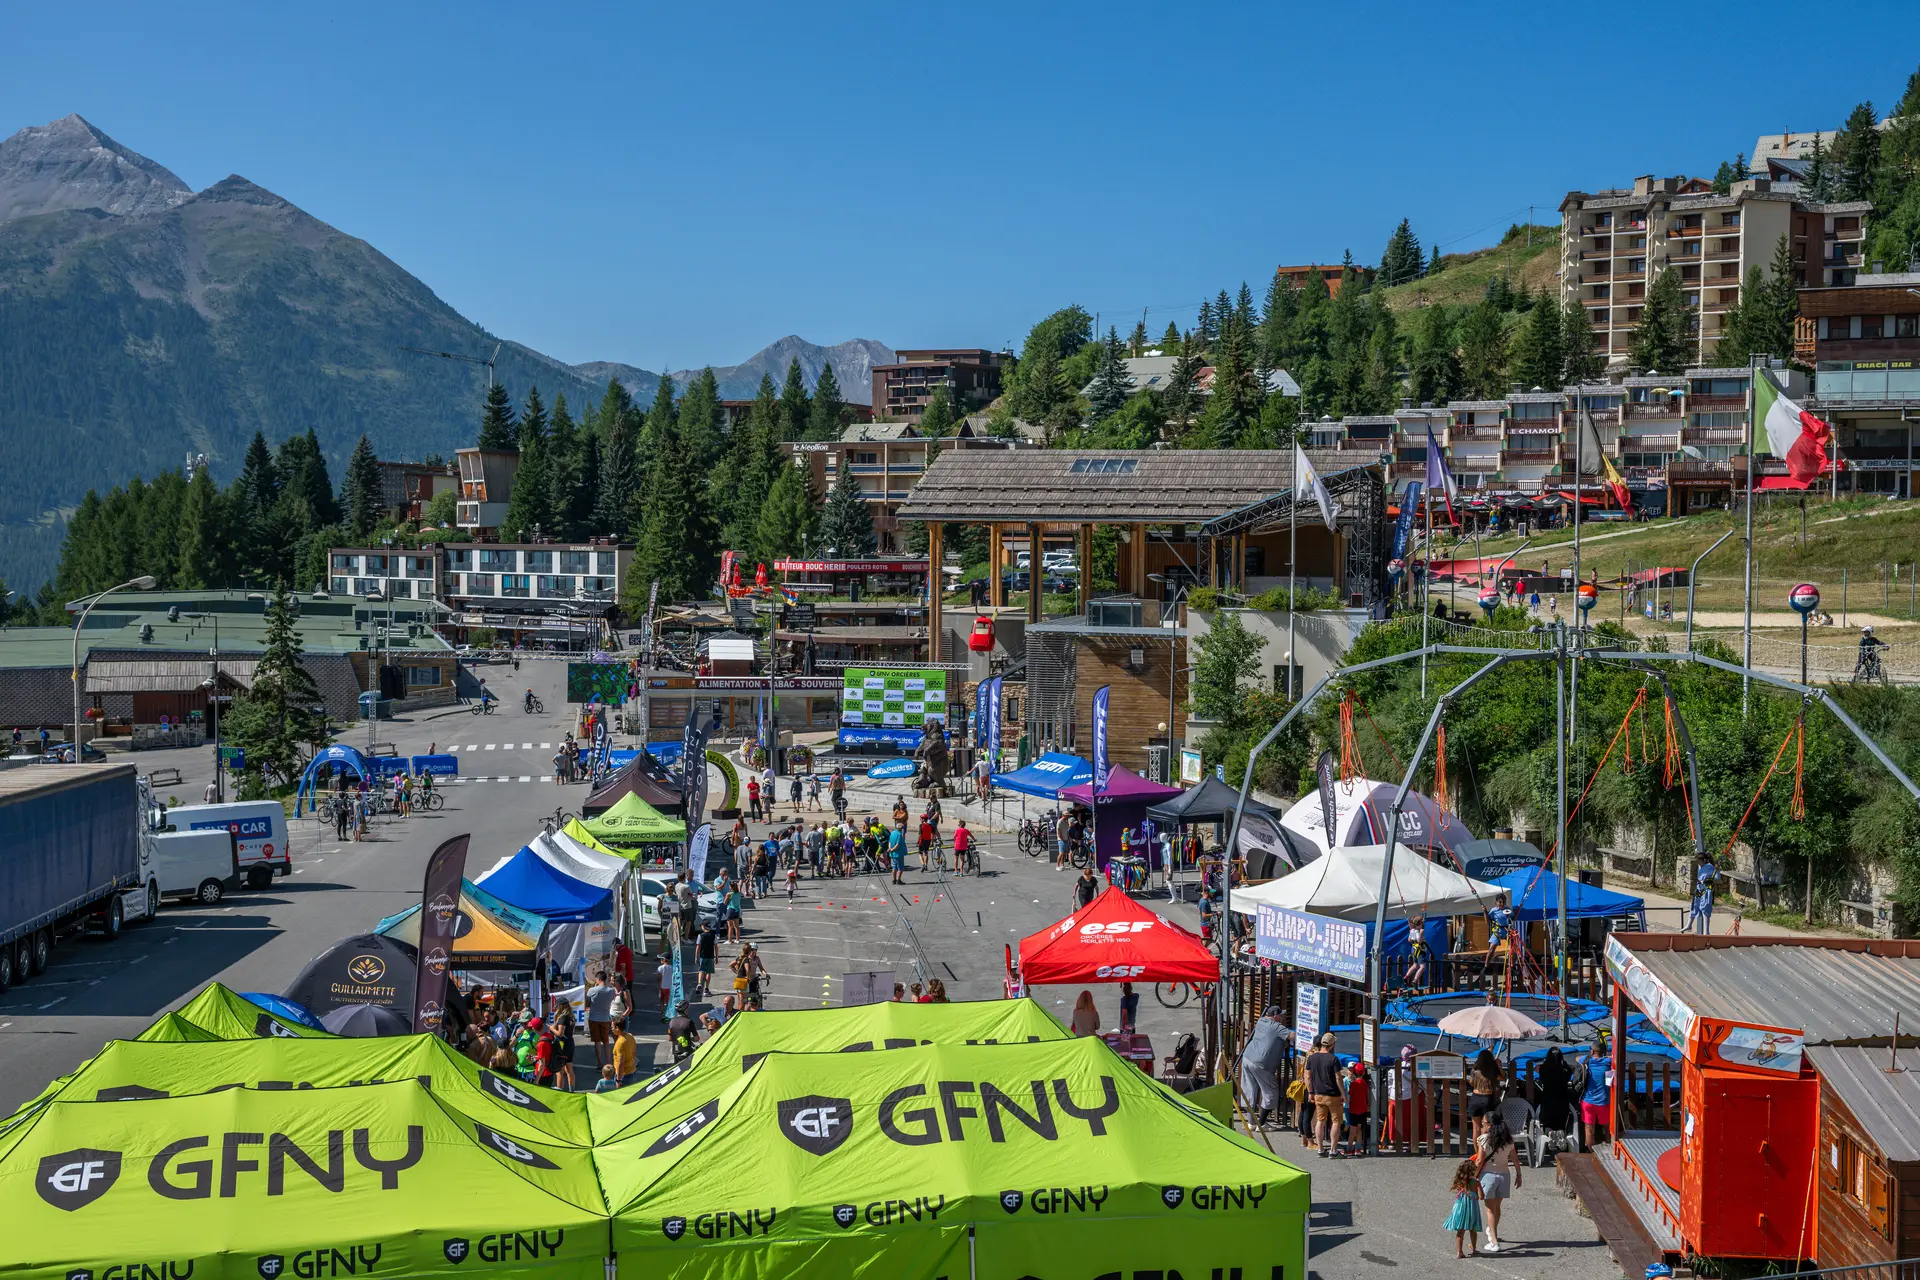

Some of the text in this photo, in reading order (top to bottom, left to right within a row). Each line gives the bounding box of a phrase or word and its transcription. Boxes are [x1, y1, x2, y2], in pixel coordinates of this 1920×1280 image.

[699, 680, 761, 688] ALIMENTATION
[887, 764, 912, 772] Orcières
[1324, 764, 1335, 799] Cyclard
[240, 822, 267, 834] CAR
[1328, 802, 1336, 833] French
[1258, 905, 1364, 958] TRAMPO-JUMP
[1258, 945, 1281, 956] Plaisir
[1334, 961, 1364, 972] assurés
[331, 982, 396, 997] GUILLAUMETTE
[878, 1076, 1120, 1147] GFNY
[148, 1125, 424, 1200] GFNY
[865, 1194, 944, 1226] GFNY
[1031, 1185, 1108, 1214] GFNY
[1192, 1183, 1268, 1211] GFNY
[694, 1208, 776, 1240] GFNY
[293, 1244, 382, 1278] GFNY
[478, 1229, 564, 1262] GFNY
